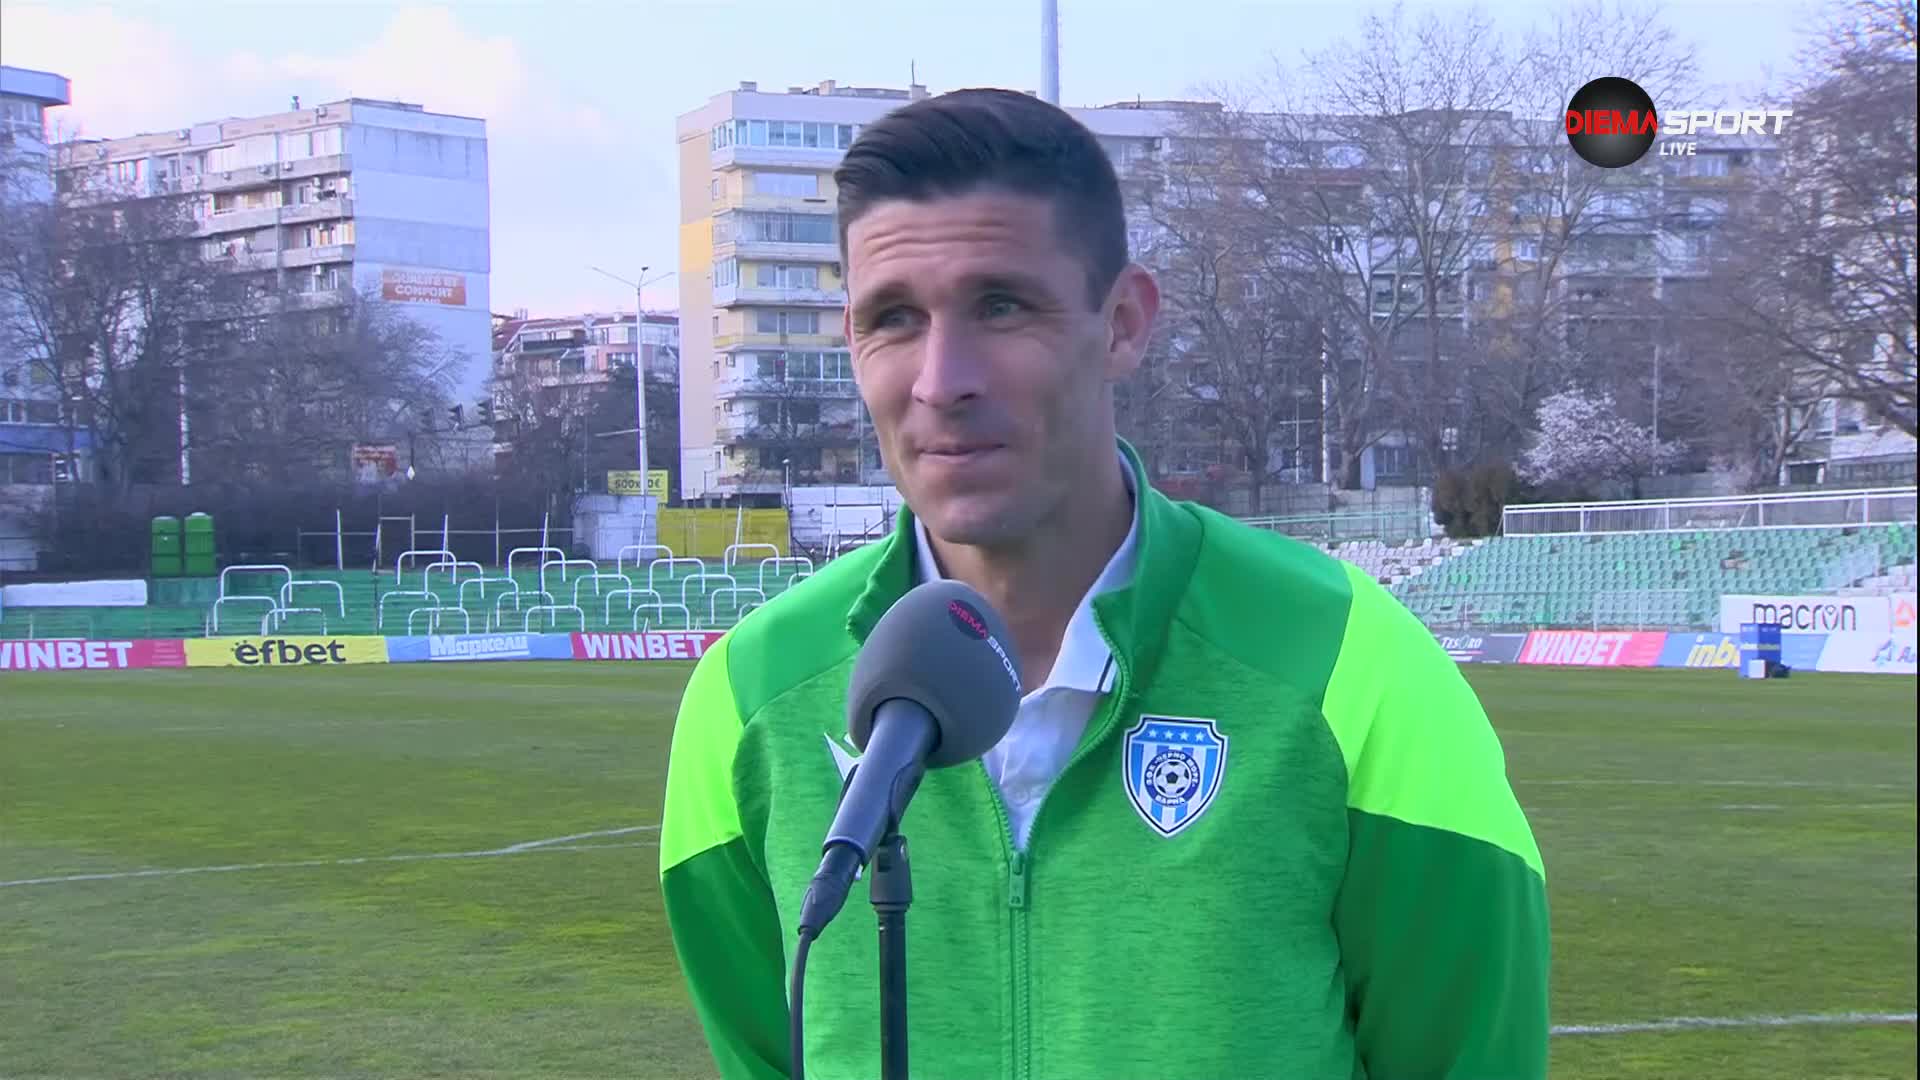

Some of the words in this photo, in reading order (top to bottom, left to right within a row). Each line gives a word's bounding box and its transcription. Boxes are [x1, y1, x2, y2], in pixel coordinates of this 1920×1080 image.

[1753, 603, 1856, 631] macron
[429, 634, 528, 657] Маркели
[580, 633, 705, 659] WINBET
[947, 601, 988, 638] DIEMA
[987, 635, 1021, 692] SPORT
[1441, 634, 1483, 649] TESORO
[1526, 633, 1633, 665] WINBET
